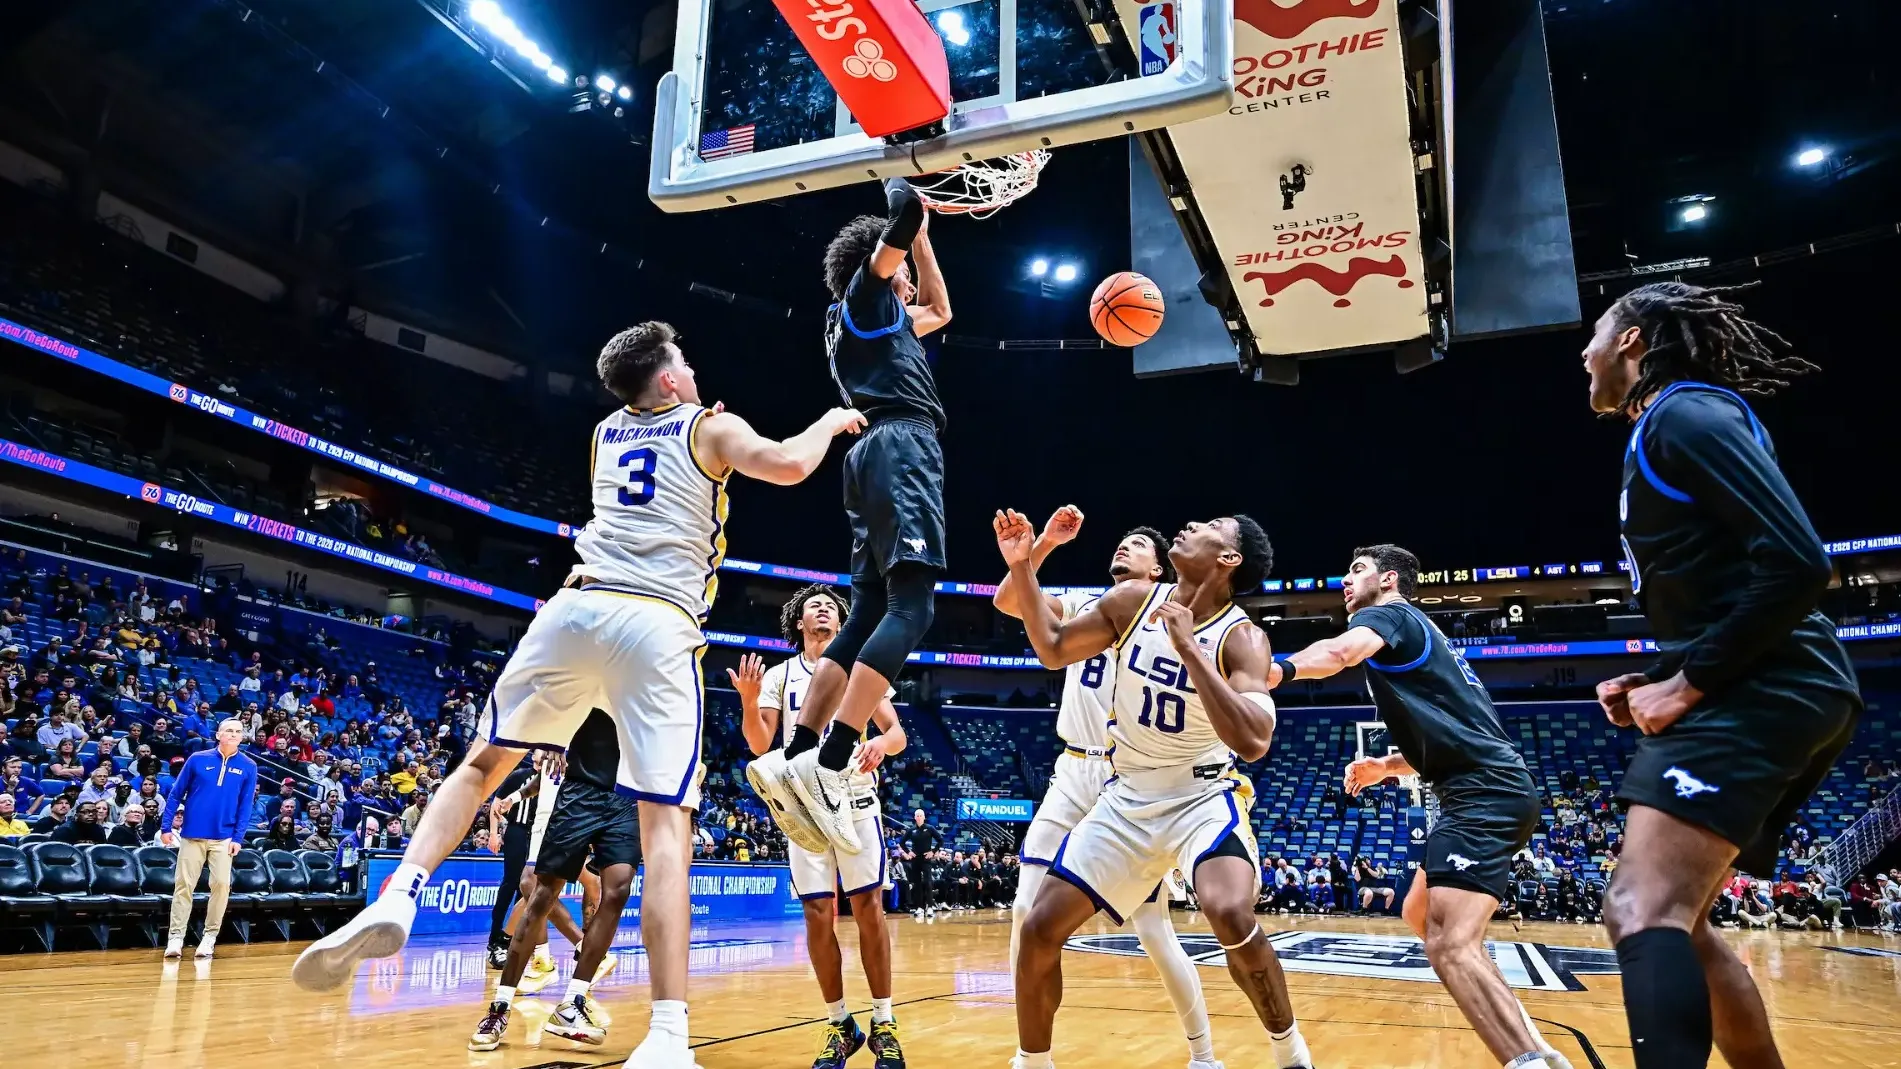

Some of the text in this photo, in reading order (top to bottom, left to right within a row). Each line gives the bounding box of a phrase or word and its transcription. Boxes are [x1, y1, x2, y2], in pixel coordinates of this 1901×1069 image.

[1145, 61, 1163, 75] NBA
[1228, 90, 1331, 116] CENTER
[1272, 212, 1360, 231] CENTER
[1234, 231, 1412, 267] SMOOTHIE
[191, 393, 202, 406] THE
[200, 395, 219, 413] GO
[602, 420, 685, 444] MACKINNON
[252, 415, 267, 429] WIN
[265, 419, 274, 434] 2
[273, 422, 309, 447] TICKETS
[308, 436, 316, 448] TO
[316, 440, 328, 452] THE
[354, 454, 380, 472] NATIONAL
[379, 463, 419, 486] CHAMPIONSHIP
[617, 447, 657, 506] 3
[165, 492, 214, 516] THE GO ROUTE
[233, 511, 250, 526] WIN
[248, 514, 257, 530] 2
[257, 516, 296, 541] TICKETS
[295, 529, 304, 542] TO
[304, 532, 318, 545] THE
[333, 541, 347, 554] CFP
[345, 544, 374, 561] NATIONAL
[373, 553, 417, 573] CHAMPIONSHIP
[1852, 539, 1867, 550] CFP
[1867, 535, 1901, 549] NATIONAL
[723, 558, 762, 572] CHAMPIONSHIP
[1486, 567, 1518, 580] LSU
[1533, 566, 1541, 576] 4
[1547, 566, 1563, 575] AST
[1582, 563, 1601, 573] REB
[285, 570, 308, 594] 114
[1453, 569, 1469, 582] 25
[966, 583, 972, 594] 2
[706, 632, 747, 644] CHAMPIONSHIP
[946, 653, 953, 664] 2
[952, 653, 981, 666] TICKETS
[1079, 653, 1107, 690] 8
[1137, 685, 1186, 734] 10
[1087, 749, 1103, 757] LSU
[228, 767, 243, 776] LSU
[979, 804, 1028, 816] FANDUEL
[723, 875, 777, 896] CHAMPIONSHIP
[419, 886, 441, 908] THE
[439, 878, 470, 914] GO
